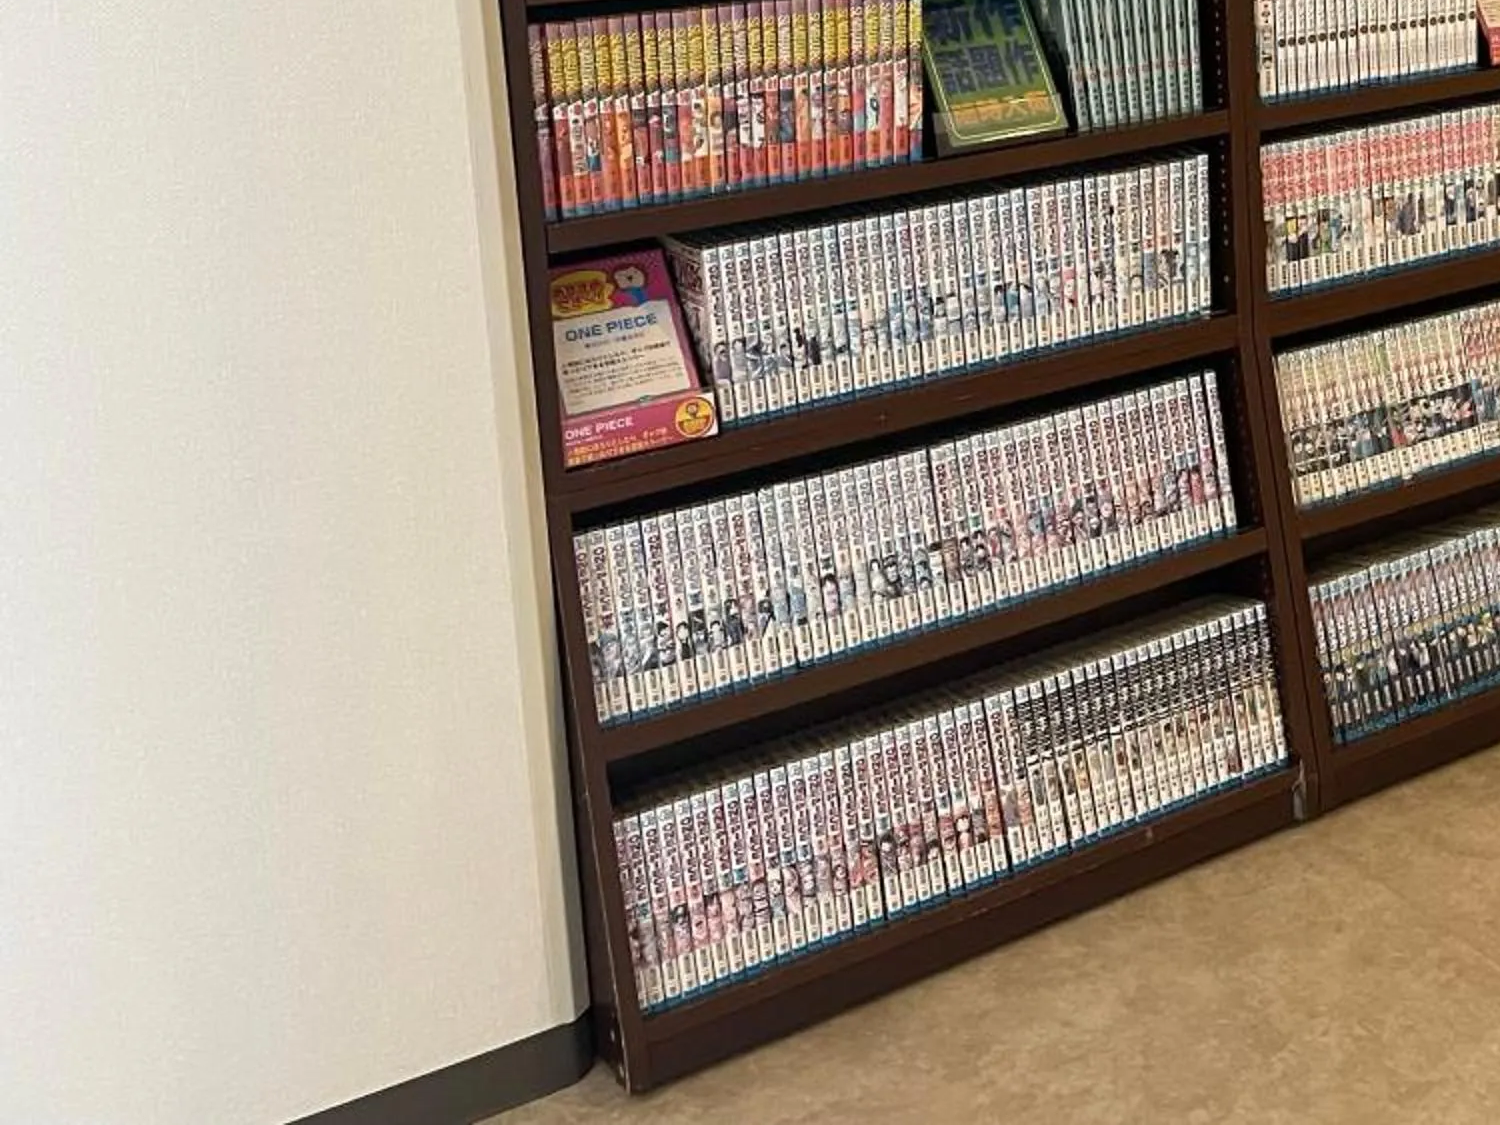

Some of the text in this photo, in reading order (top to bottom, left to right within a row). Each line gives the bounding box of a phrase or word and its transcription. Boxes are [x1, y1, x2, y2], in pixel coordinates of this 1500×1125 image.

[565, 313, 658, 342] ONE PIECE
[565, 416, 634, 440] ONE PIECE
